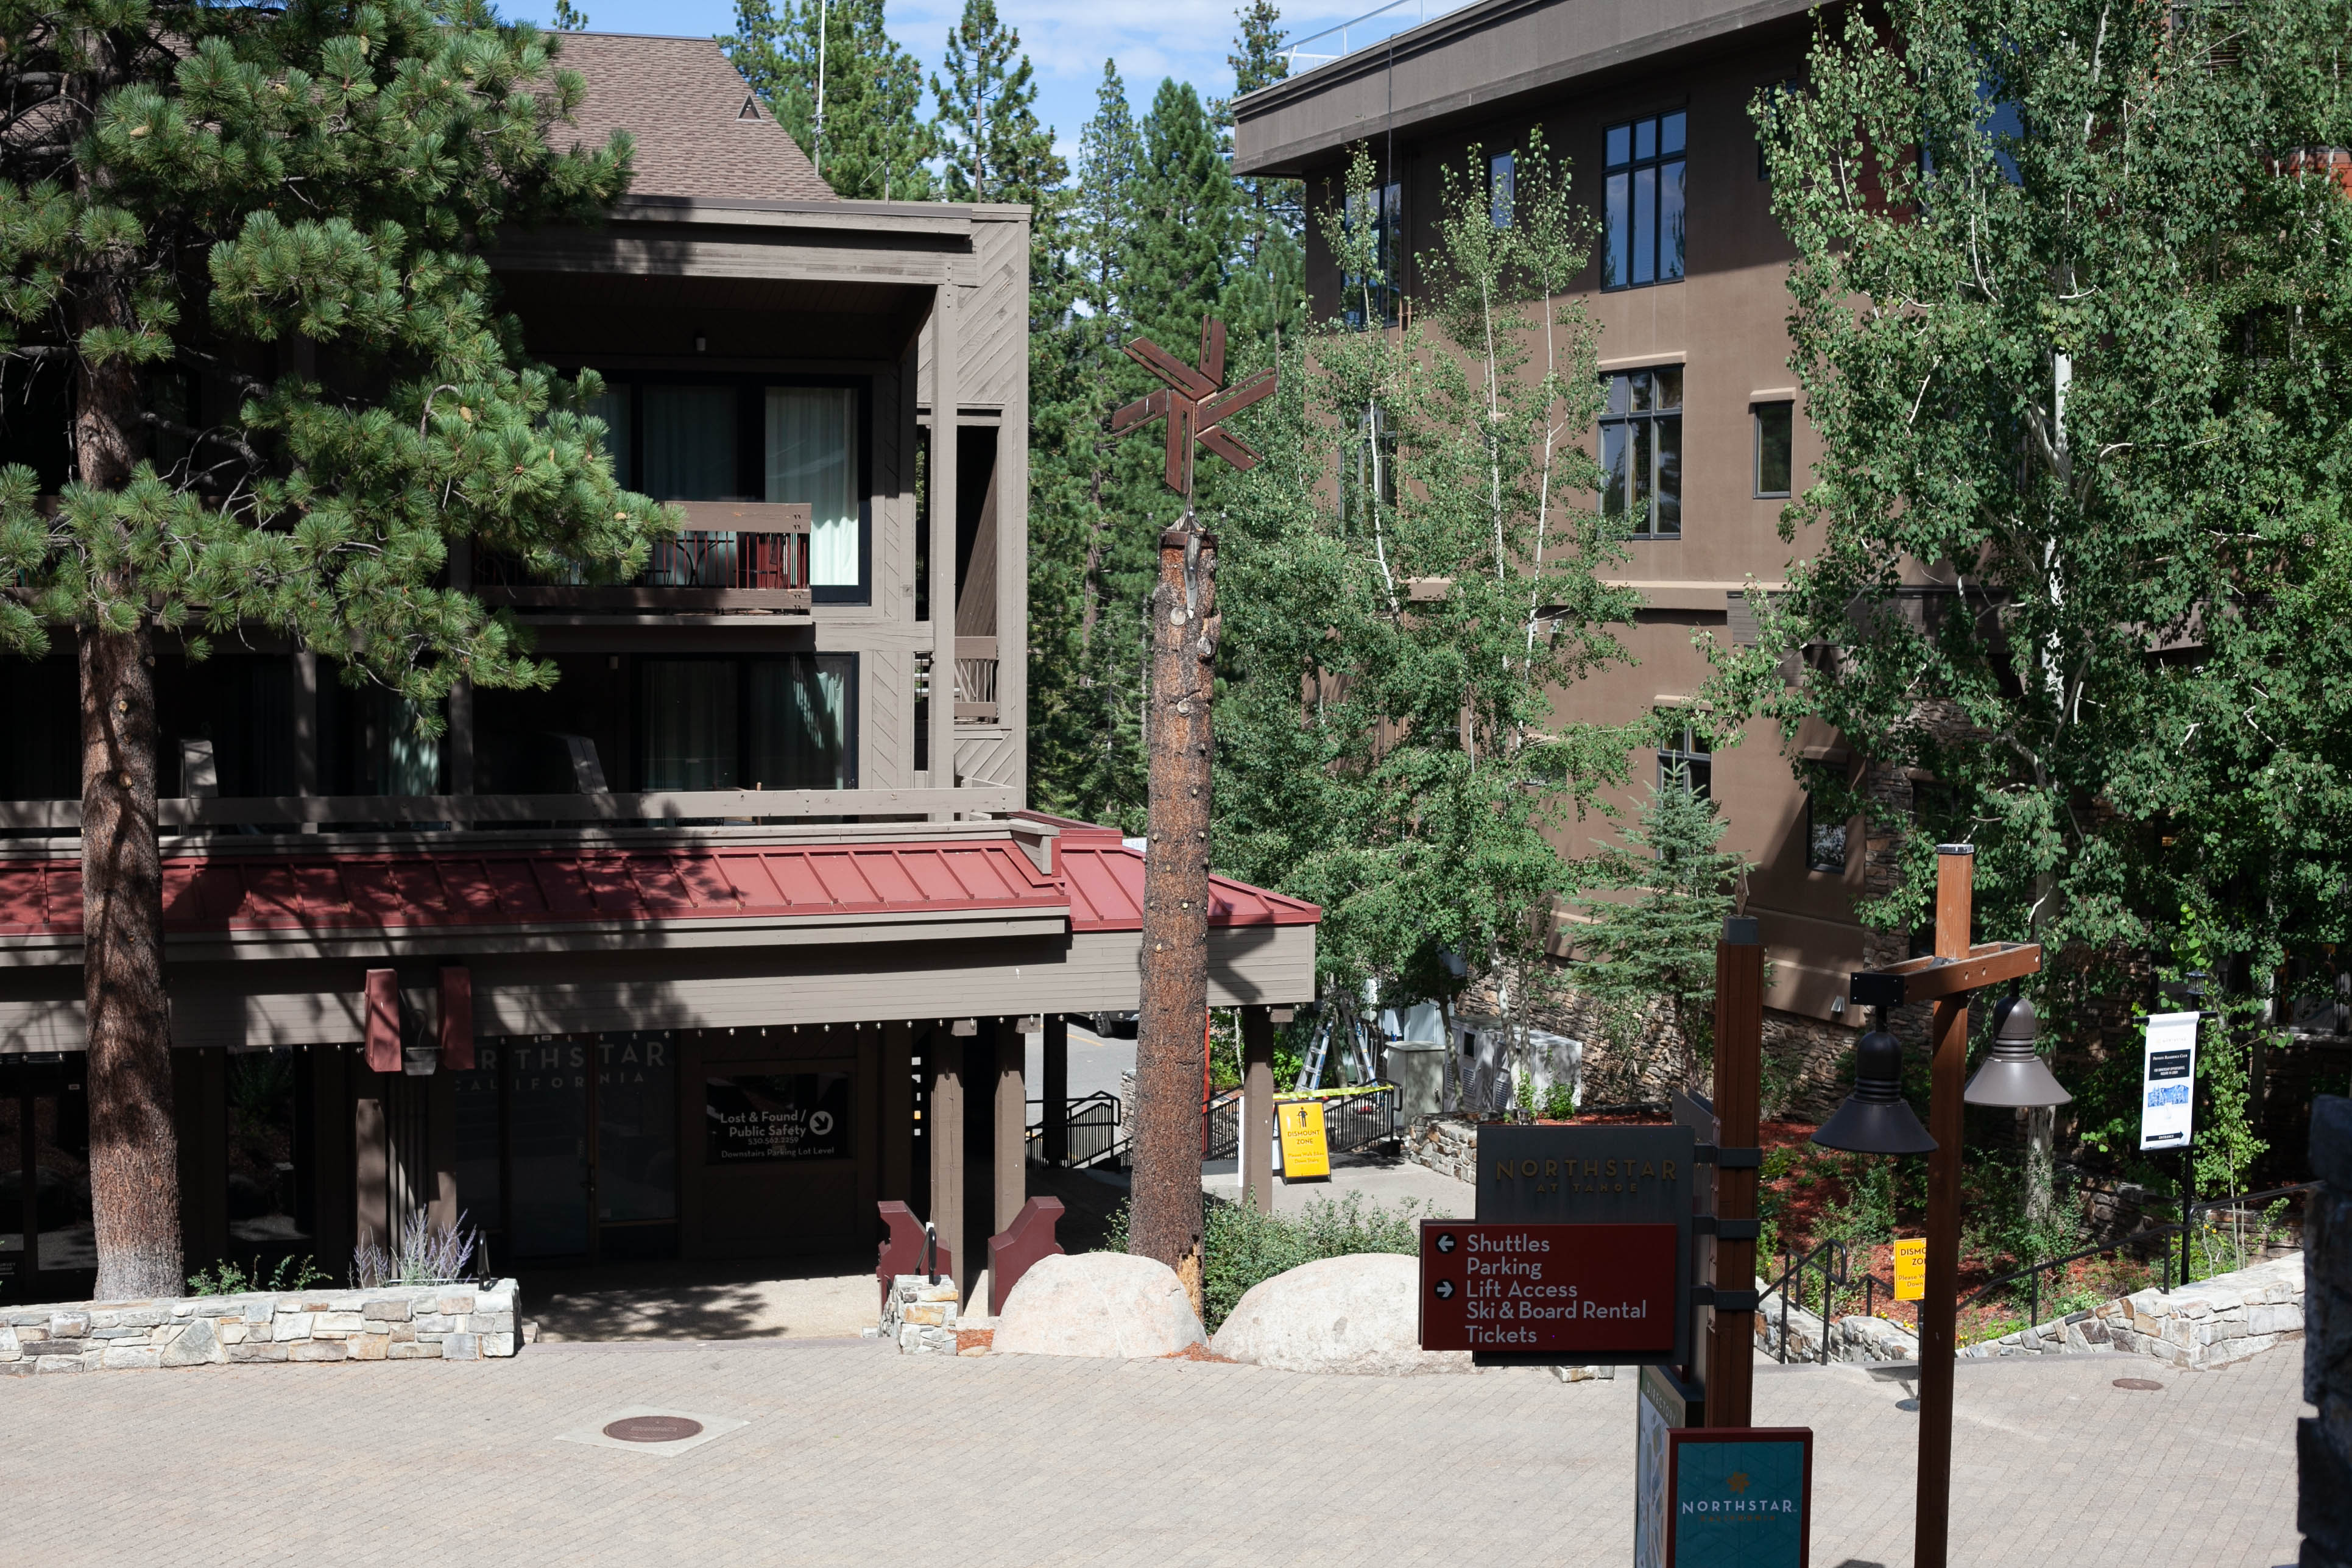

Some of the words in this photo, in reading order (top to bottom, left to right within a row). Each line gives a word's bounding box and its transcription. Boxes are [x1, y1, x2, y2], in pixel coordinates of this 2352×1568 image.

[481, 1042, 666, 1070] RTHSTAR
[721, 1112, 746, 1124] Lost
[749, 1112, 758, 1123] &
[761, 1109, 798, 1123] Found
[729, 1125, 765, 1137] Public
[768, 1124, 807, 1138] Safety
[747, 1137, 799, 1145] 530.562.2259
[766, 1148, 796, 1158] Parking
[799, 1146, 811, 1155] Lot
[813, 1146, 834, 1156] Level
[1496, 1159, 1676, 1181] NORTHSTAR
[1536, 1184, 1558, 1193] AT
[1572, 1184, 1638, 1193] TAHOE
[1466, 1233, 1550, 1252] Shuttles
[1467, 1256, 1542, 1280] Parking
[1466, 1279, 1502, 1298] Lift
[1508, 1280, 1578, 1298] Access
[1466, 1300, 1495, 1319] Ski
[1499, 1301, 1514, 1319] &
[1519, 1300, 1577, 1319] Board
[1583, 1299, 1647, 1319] Rental
[1464, 1324, 1538, 1343] Tickets
[1647, 1380, 1676, 1427] DIRECTORY
[1683, 1500, 1792, 1514] NORTHSTAR
